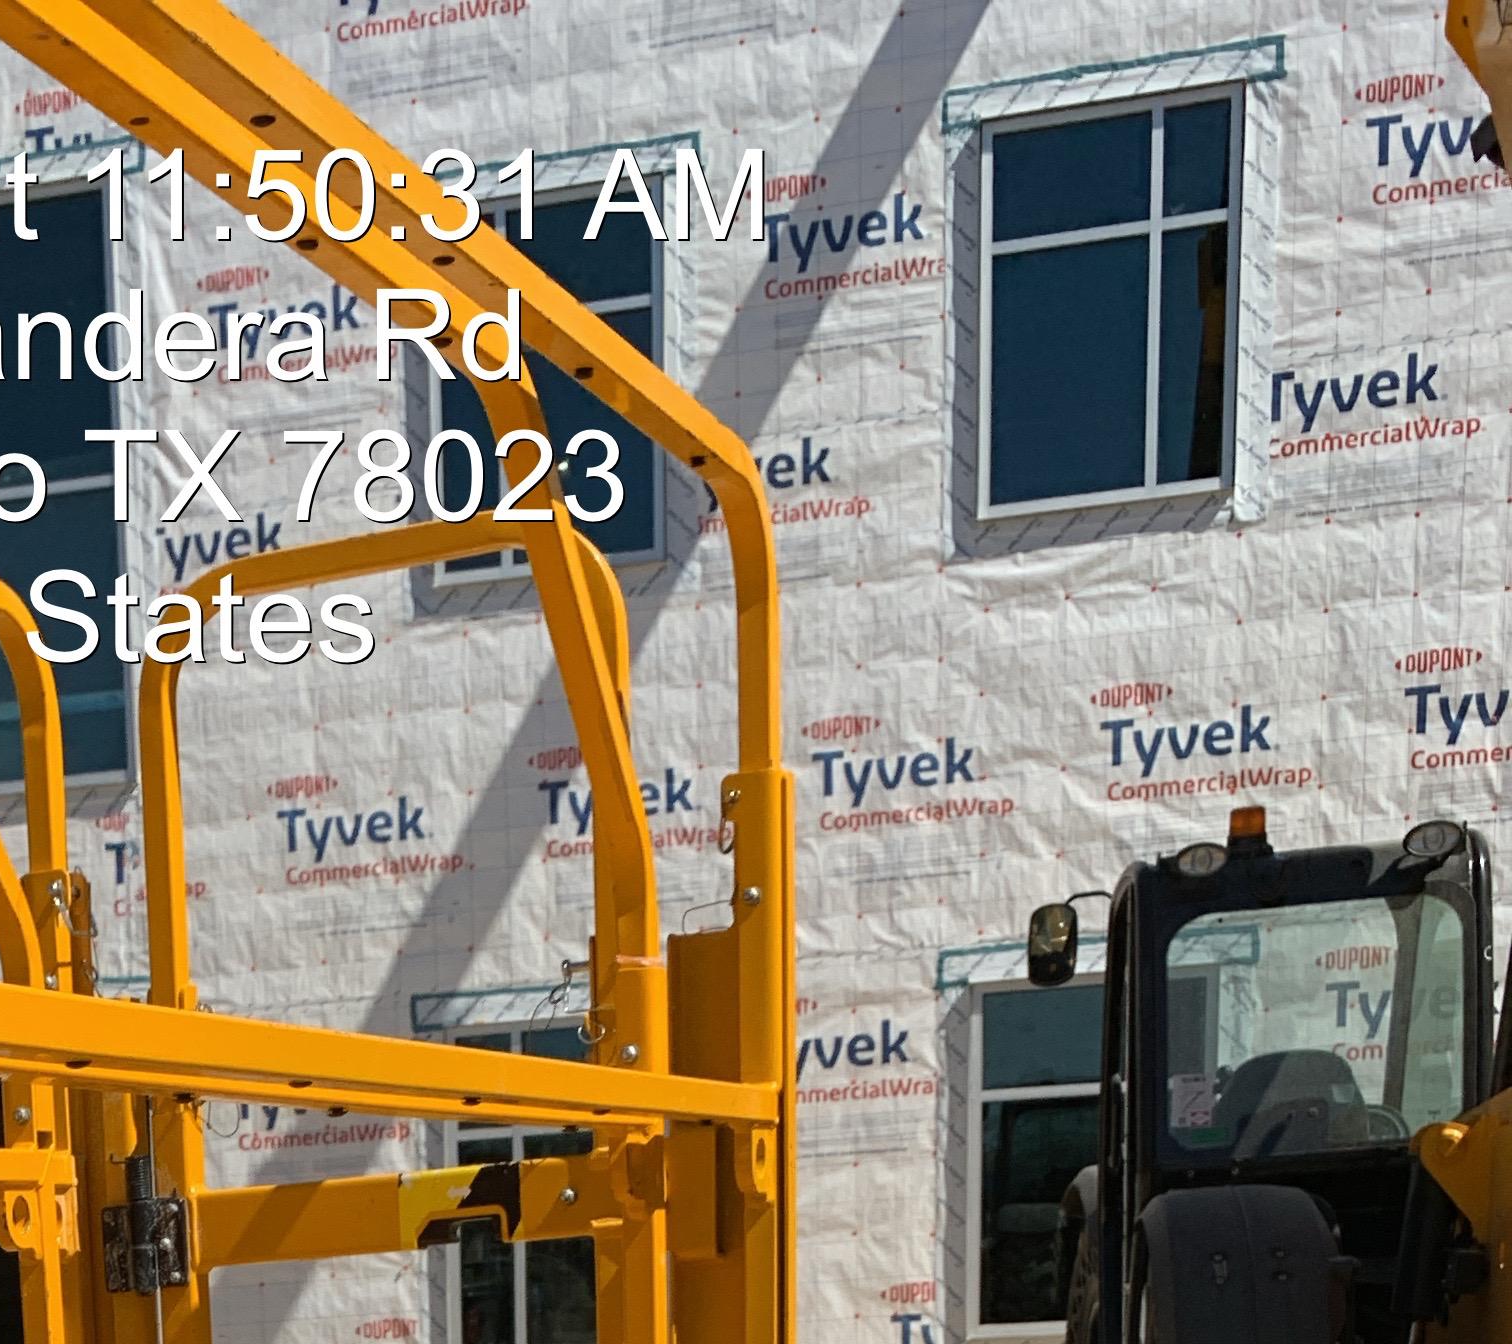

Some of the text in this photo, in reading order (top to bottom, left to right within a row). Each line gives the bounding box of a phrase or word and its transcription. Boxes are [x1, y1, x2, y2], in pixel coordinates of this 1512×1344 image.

[1366, 75, 1436, 103] DUPONT
[1366, 114, 1474, 178] Tyv
[765, 175, 819, 202] UPONT
[764, 193, 924, 273] Tyvek
[765, 256, 945, 300] CommercialWra
[1271, 352, 1439, 433] Tyvek
[156, 512, 282, 582] yvek
[1405, 647, 1473, 673] DUPONT
[1100, 683, 1165, 709] DUPONT
[1404, 683, 1509, 746] Tyv
[811, 716, 872, 740] DUPONT
[1100, 704, 1273, 777] Tyvek
[811, 737, 975, 807] Tyvek
[1107, 766, 1312, 803] CommercialWrap
[538, 768, 694, 836] Tyek
[820, 796, 1015, 832] CommercialWrap
[276, 795, 425, 863] Tyvek
[286, 853, 464, 888] CommercialWrap
[239, 1121, 410, 1151] CommercialWrap
